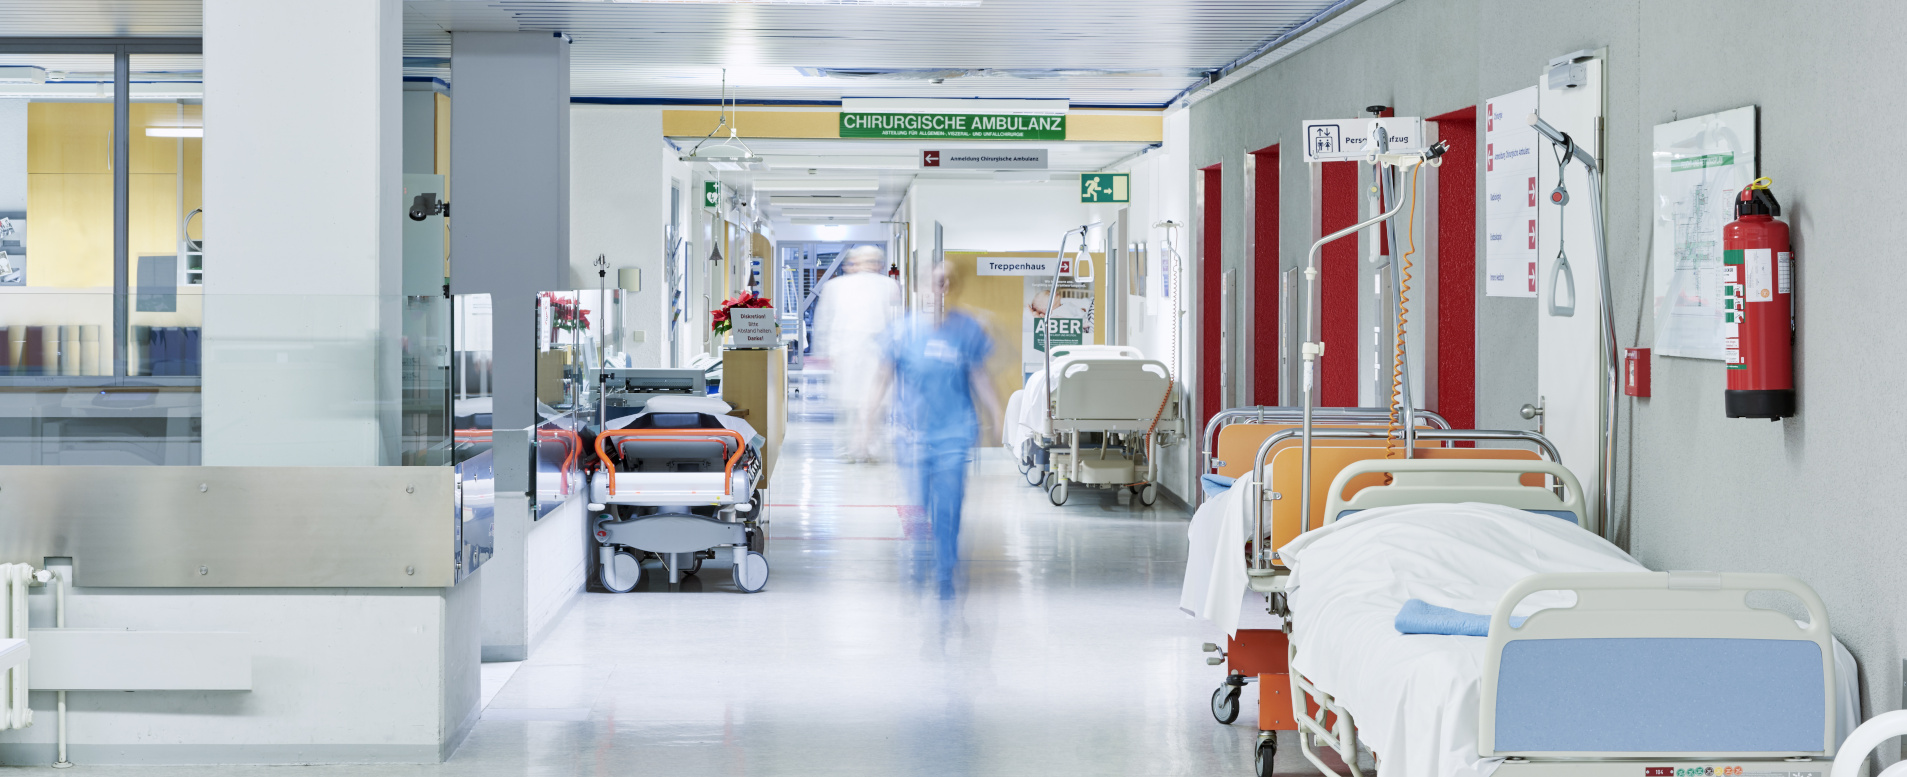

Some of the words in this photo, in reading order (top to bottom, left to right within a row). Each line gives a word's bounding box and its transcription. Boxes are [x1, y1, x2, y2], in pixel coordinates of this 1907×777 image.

[843, 115, 966, 130] CHIRURGISCHE
[971, 116, 1062, 131] AMBULANZ
[989, 262, 1046, 271] Treppenhaus
[1035, 319, 1081, 334] ABER
